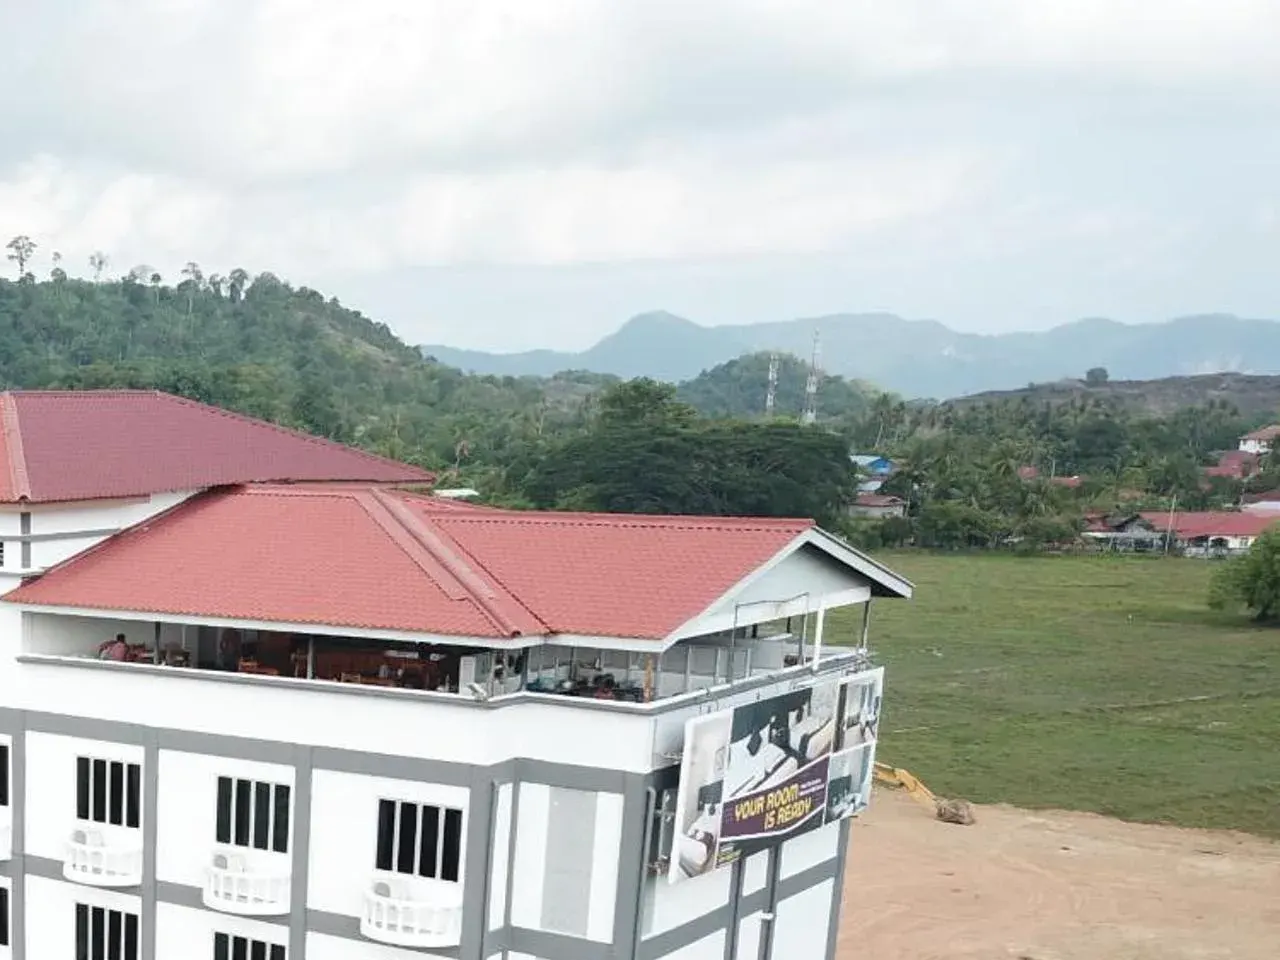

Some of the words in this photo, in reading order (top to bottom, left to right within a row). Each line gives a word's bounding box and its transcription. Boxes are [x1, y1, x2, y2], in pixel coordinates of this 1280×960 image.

[735, 796, 765, 822] YOUR
[766, 783, 799, 811] ROOM
[764, 810, 776, 831] IS
[777, 796, 812, 825] READY
